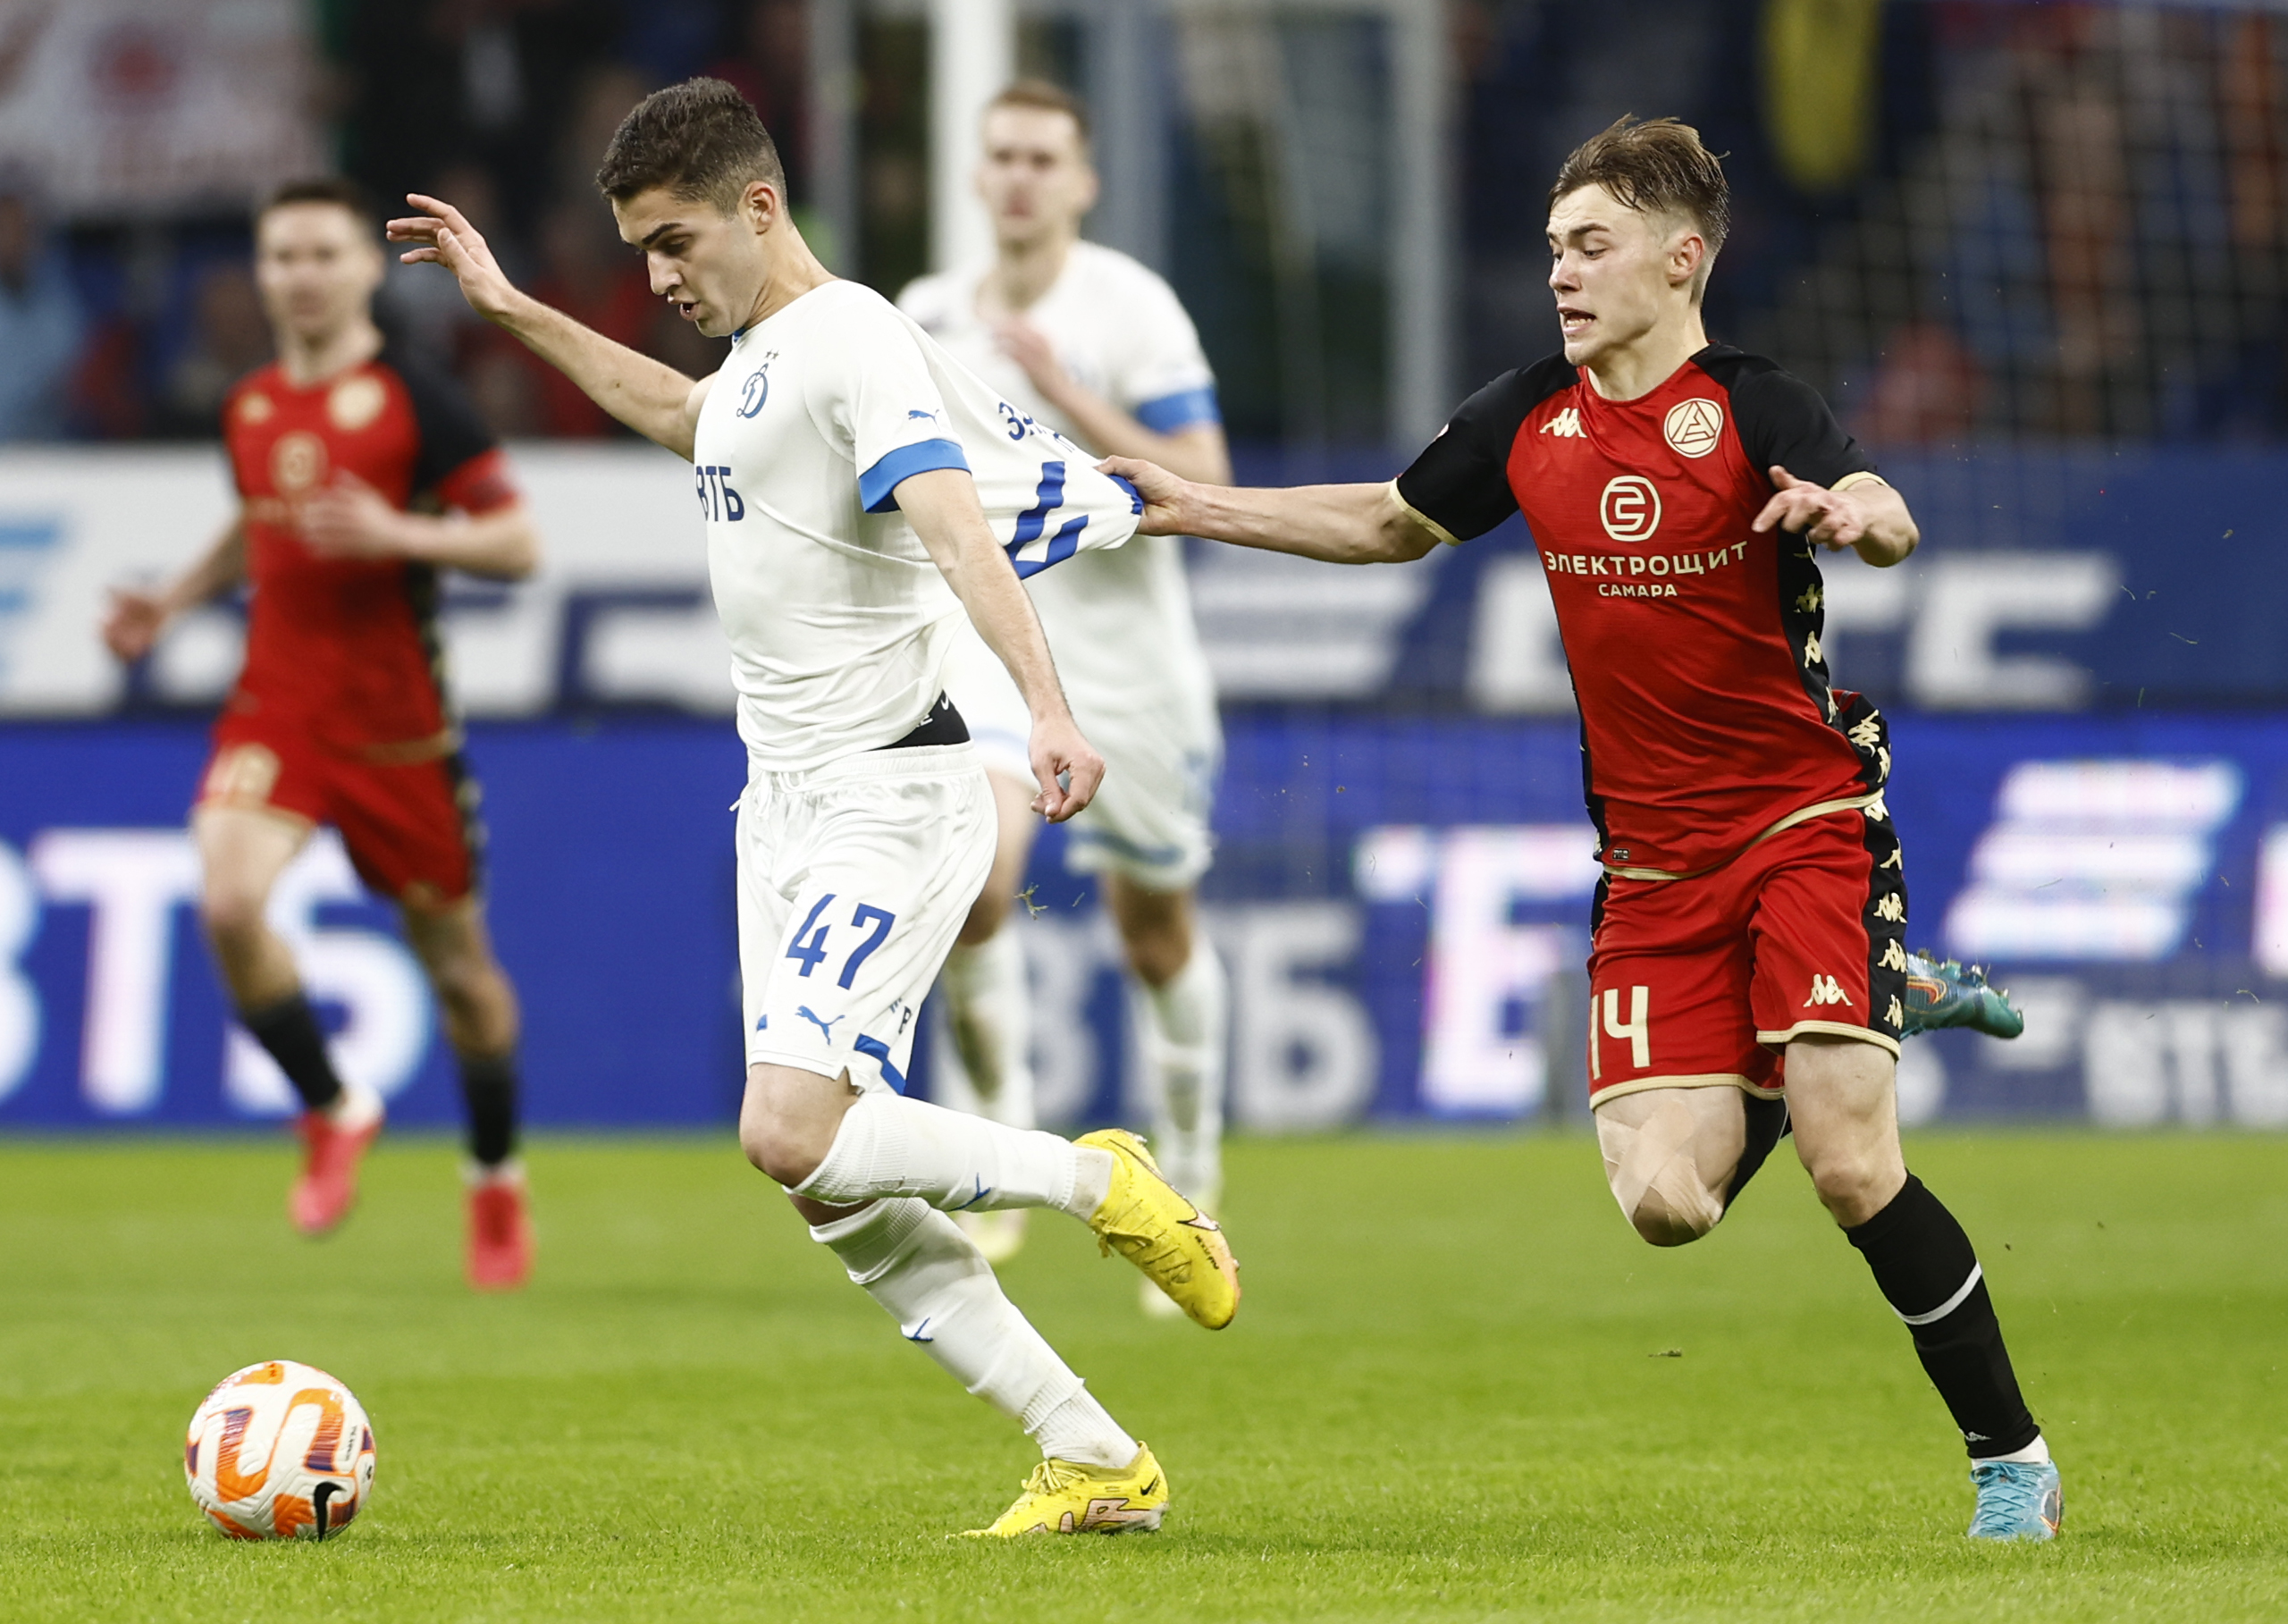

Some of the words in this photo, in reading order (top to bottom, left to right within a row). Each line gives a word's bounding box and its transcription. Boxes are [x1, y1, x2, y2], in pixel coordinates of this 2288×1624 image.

[695, 465, 745, 523] ВТБ
[1544, 540, 1748, 576] ЭЛЕКТРОЩИТ
[1598, 584, 1678, 598] САМАРА
[785, 893, 896, 991] 47
[1590, 985, 1651, 1080] 14
